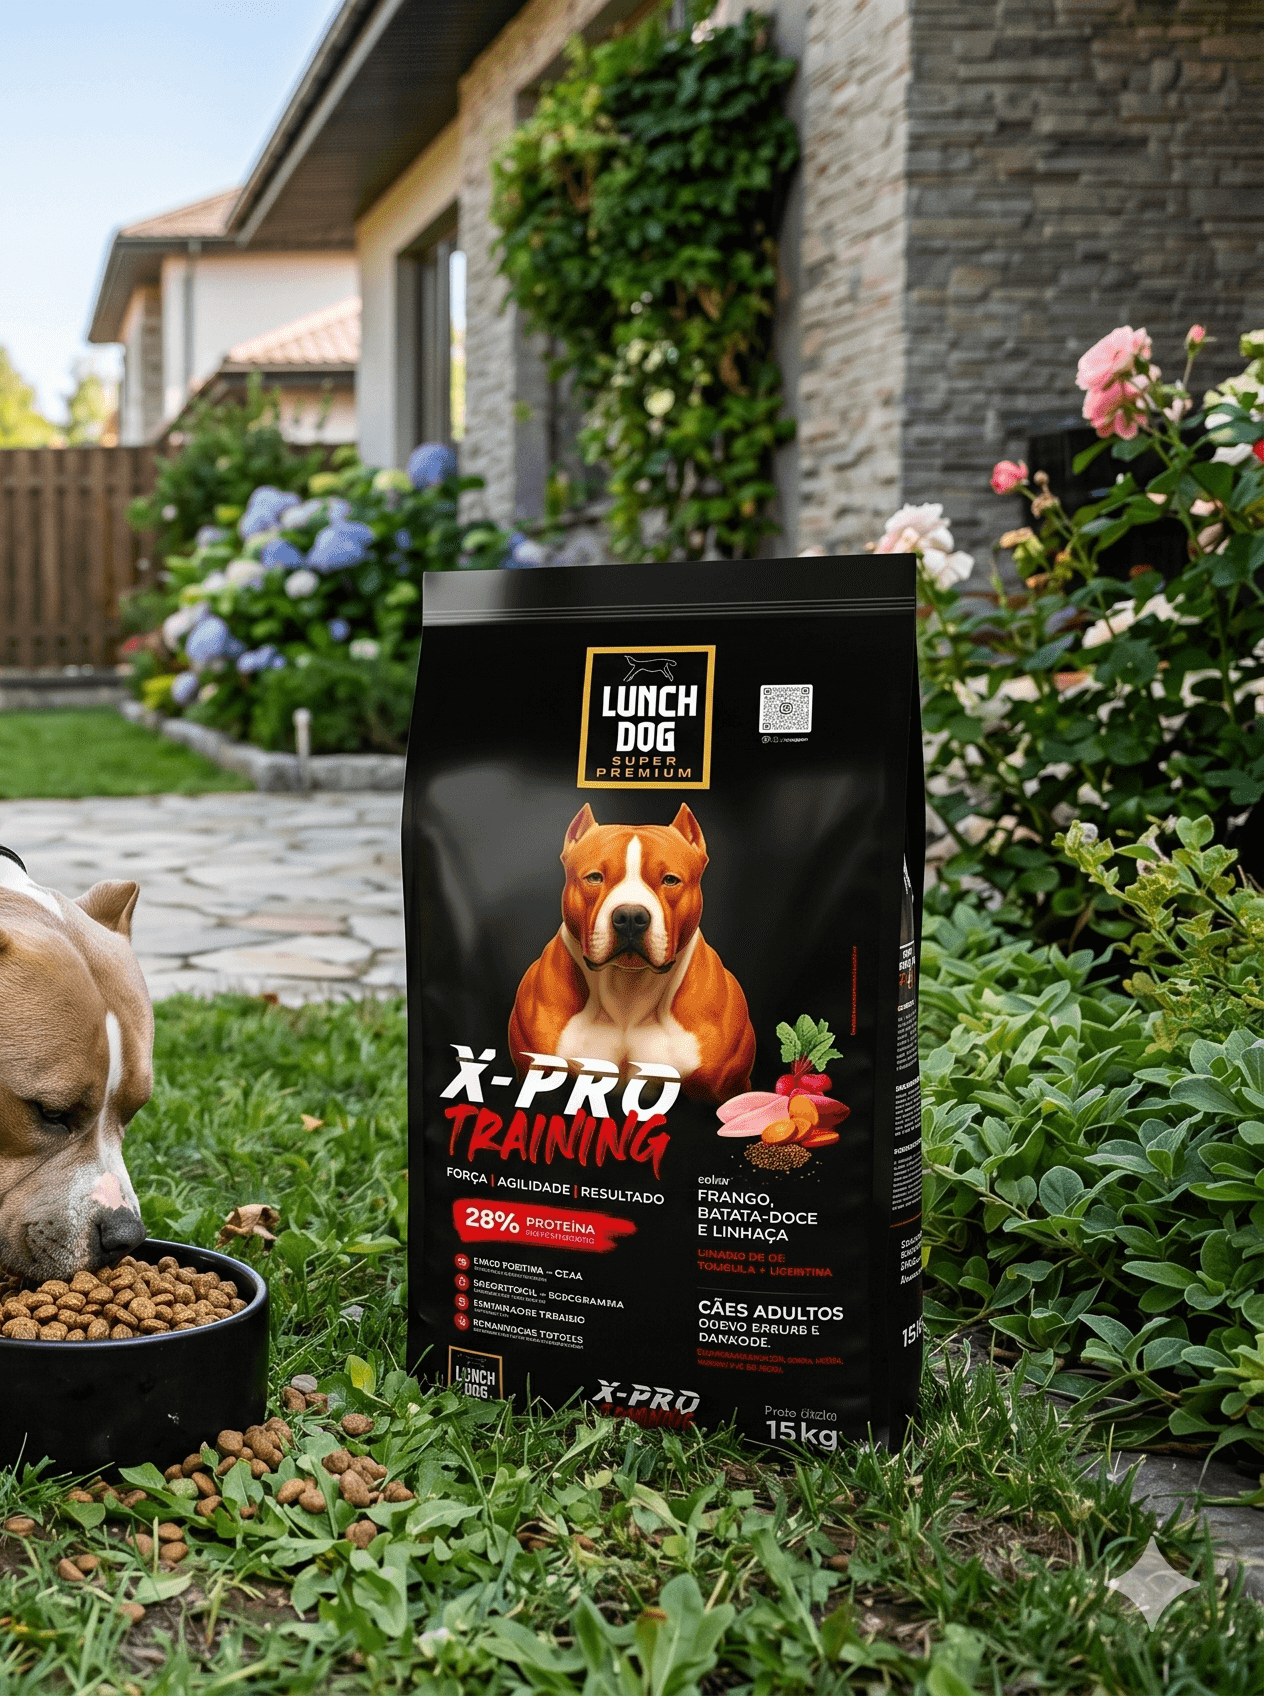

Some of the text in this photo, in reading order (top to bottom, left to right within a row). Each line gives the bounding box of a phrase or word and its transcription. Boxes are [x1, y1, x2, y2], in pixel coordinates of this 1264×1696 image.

[602, 685, 698, 717] LUNCH
[616, 721, 676, 752] DOG
[596, 768, 692, 778] PREMIUM
[612, 756, 677, 766] SUPER
[439, 1043, 682, 1122] X-PRO
[444, 1103, 671, 1181] TRAINING
[446, 1166, 665, 1206] FORÇA AGILIDADE RESULTADO
[698, 1189, 774, 1208] FRANGO,
[465, 1207, 520, 1234] 28%
[698, 1206, 818, 1225] BATATA-DOCE
[698, 1224, 789, 1244] E LINHAÇA
[698, 1297, 844, 1321] CÃES ADULTOS
[592, 1378, 701, 1415] X-PRO
